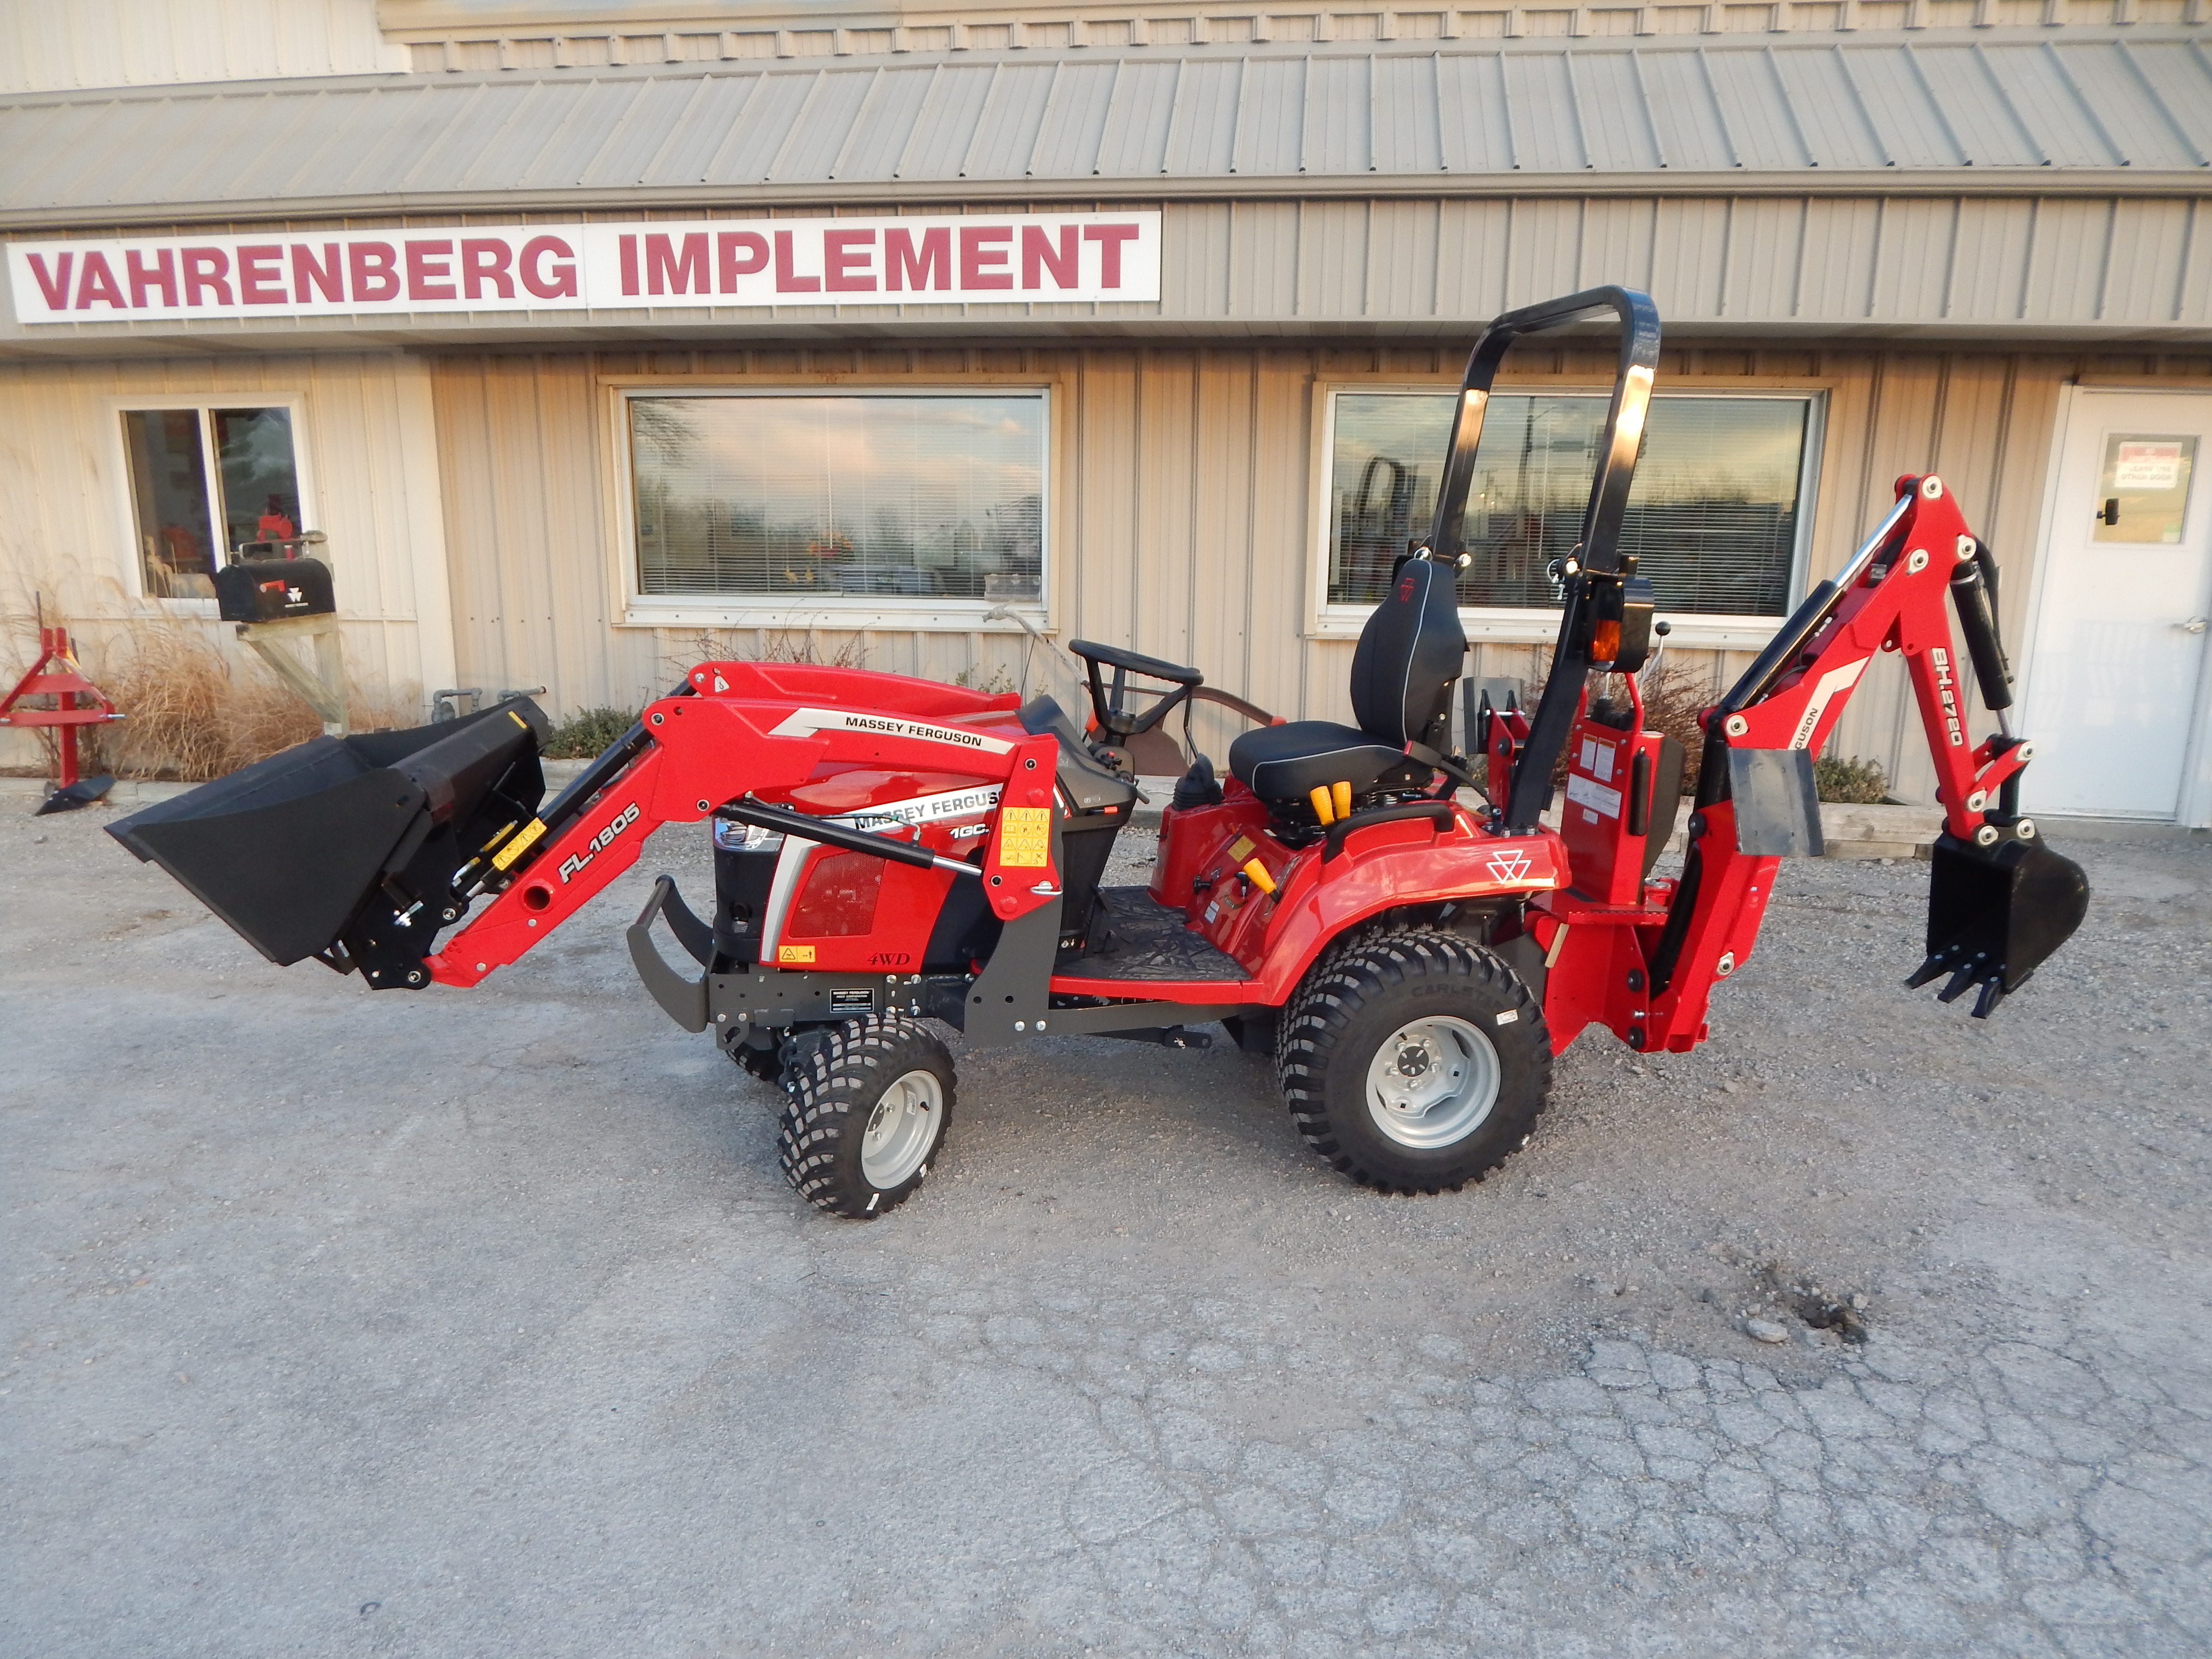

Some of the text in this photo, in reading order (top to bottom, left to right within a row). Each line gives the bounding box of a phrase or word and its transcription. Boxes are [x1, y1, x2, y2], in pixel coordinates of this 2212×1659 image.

[26, 223, 1139, 310] VAHRENBERG IMPLEMENT
[1931, 648, 1963, 746] BH.2720
[845, 717, 982, 746] MASSEY FERGUSON
[932, 791, 1001, 815] FERGUS
[558, 802, 640, 884] FL.1805
[950, 823, 992, 839] 1GC.
[867, 952, 910, 965] 4WD
